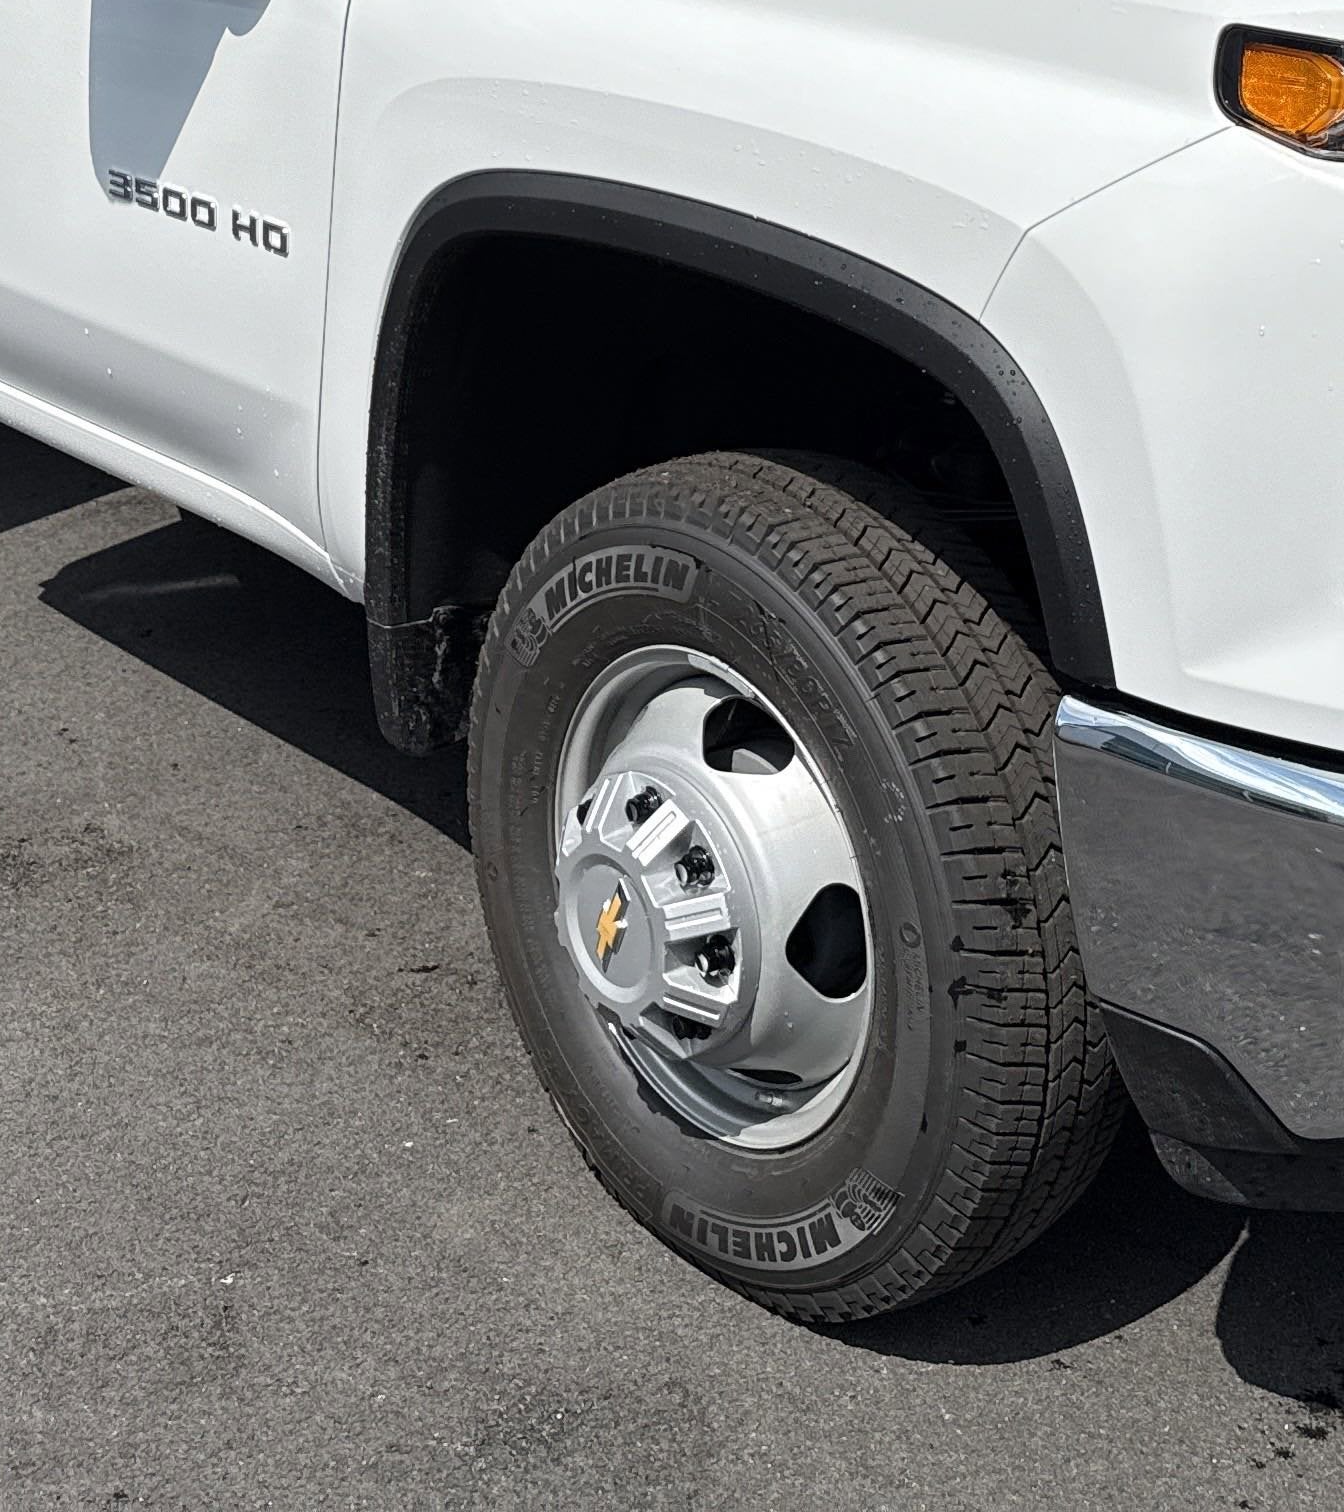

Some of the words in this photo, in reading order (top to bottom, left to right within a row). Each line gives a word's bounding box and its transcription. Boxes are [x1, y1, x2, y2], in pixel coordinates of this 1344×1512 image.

[108, 168, 218, 232] 3500
[232, 205, 290, 258] HD
[544, 553, 690, 621] MICHELIN
[669, 1203, 842, 1262] MICHELIN
